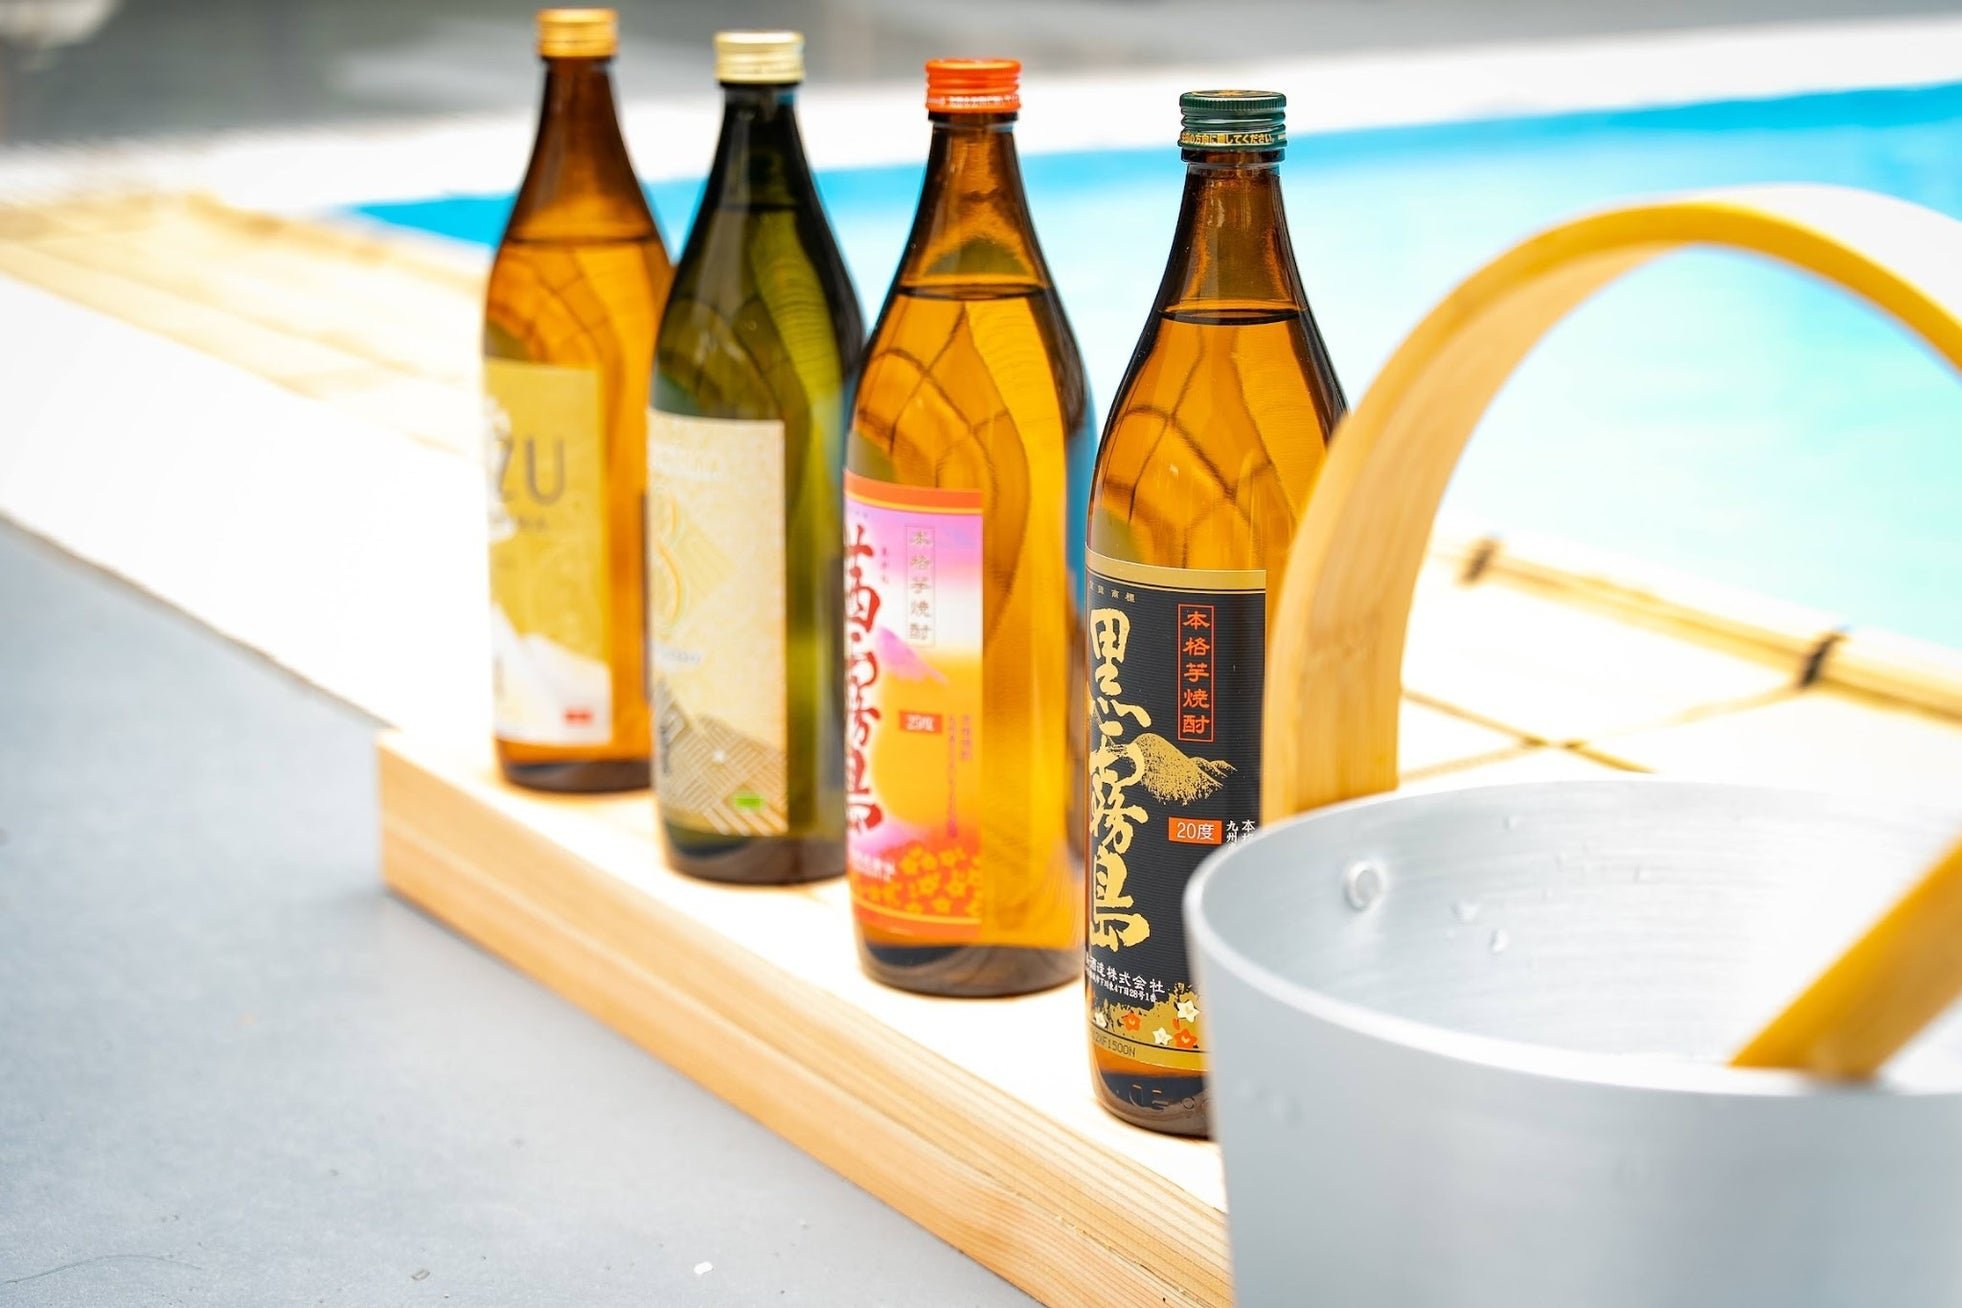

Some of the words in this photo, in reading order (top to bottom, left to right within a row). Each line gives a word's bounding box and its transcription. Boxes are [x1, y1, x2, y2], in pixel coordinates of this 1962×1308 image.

[1182, 610, 1210, 735] 本格芋焼酎
[1176, 821, 1215, 842] 20度
[1226, 819, 1239, 848] 九州
[1085, 951, 1166, 993] 酒造株式会社
